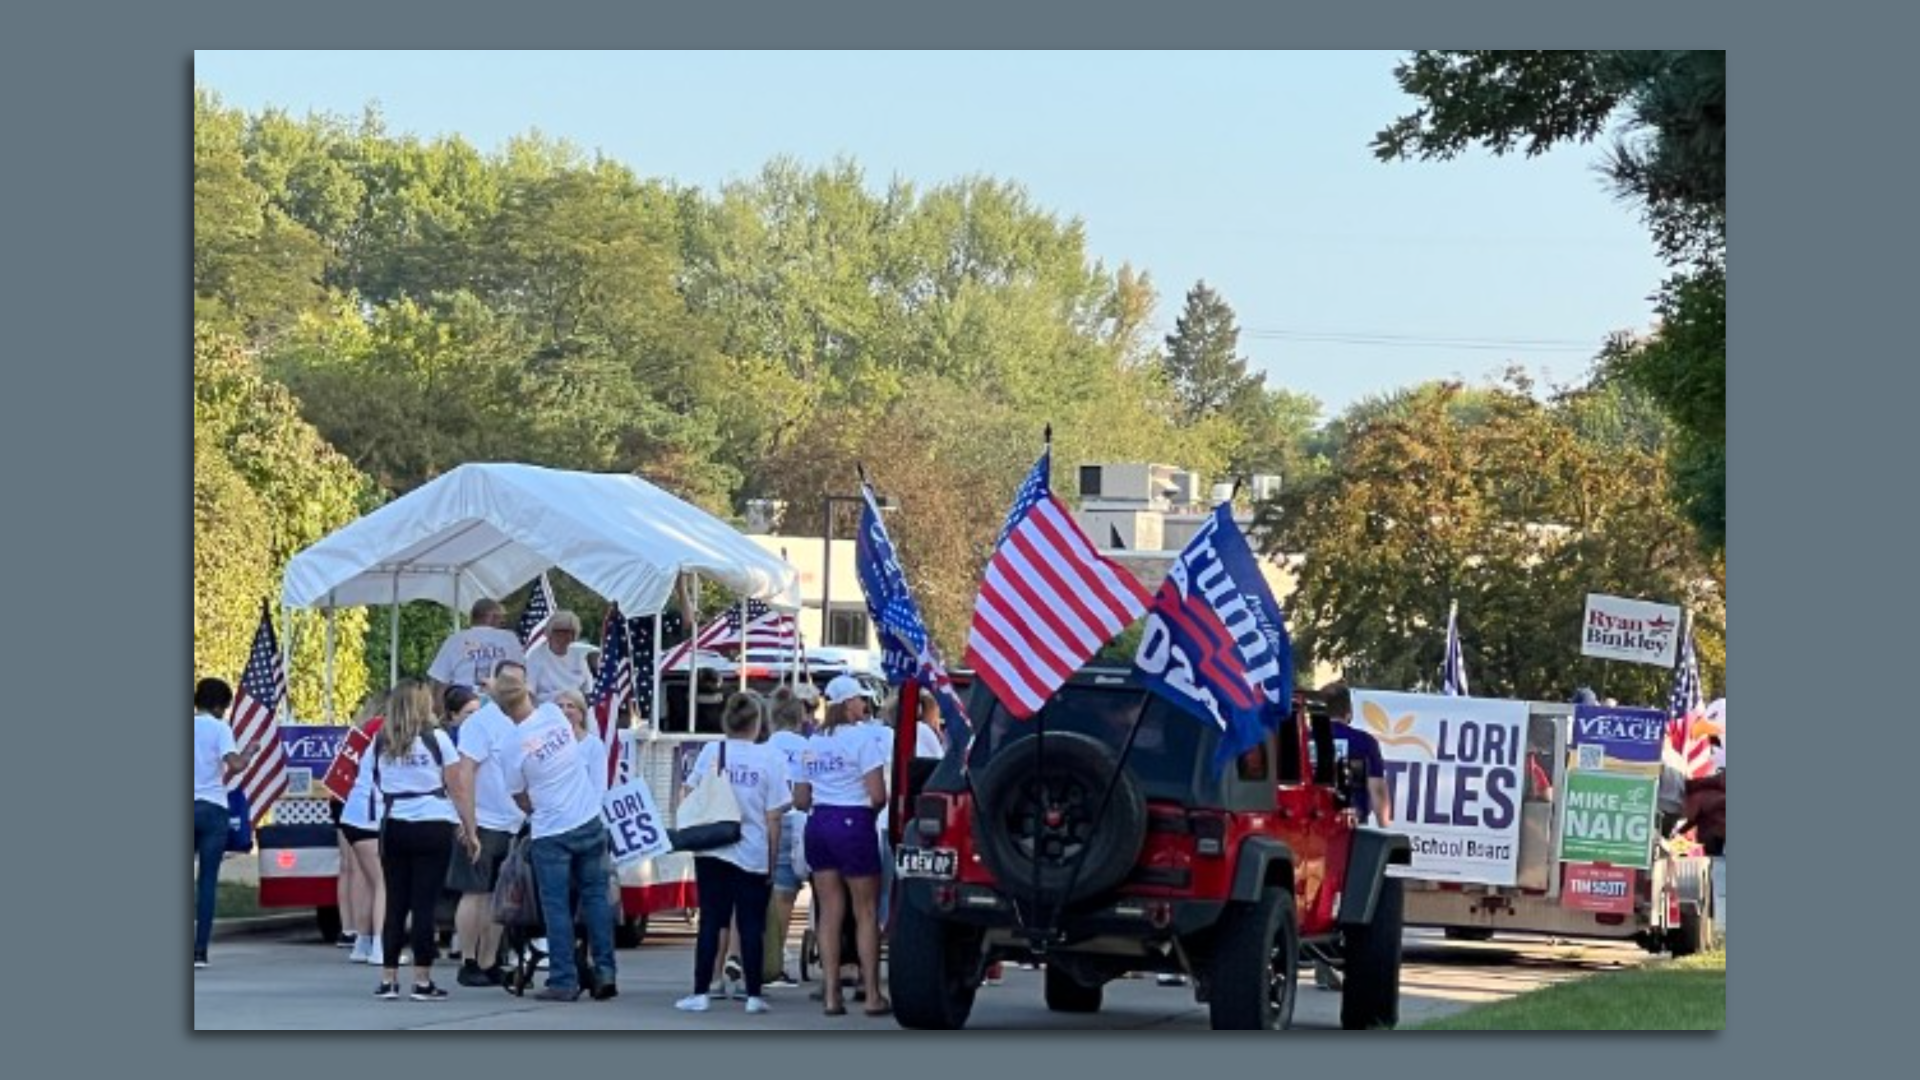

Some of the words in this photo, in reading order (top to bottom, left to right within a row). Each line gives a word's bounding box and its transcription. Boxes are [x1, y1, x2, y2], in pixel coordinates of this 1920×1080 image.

[1588, 608, 1643, 632] Ryan
[1586, 627, 1667, 657] Binkley
[1437, 720, 1520, 766] LORI
[1579, 716, 1662, 740] VEACH
[283, 737, 344, 758] VEA
[602, 790, 645, 824] LORI
[1384, 760, 1516, 829] TILES
[1568, 789, 1619, 811] MIKE
[609, 812, 658, 857] LES
[1565, 809, 1648, 842] NAIG
[1412, 835, 1464, 858] School
[1466, 840, 1511, 860] Board
